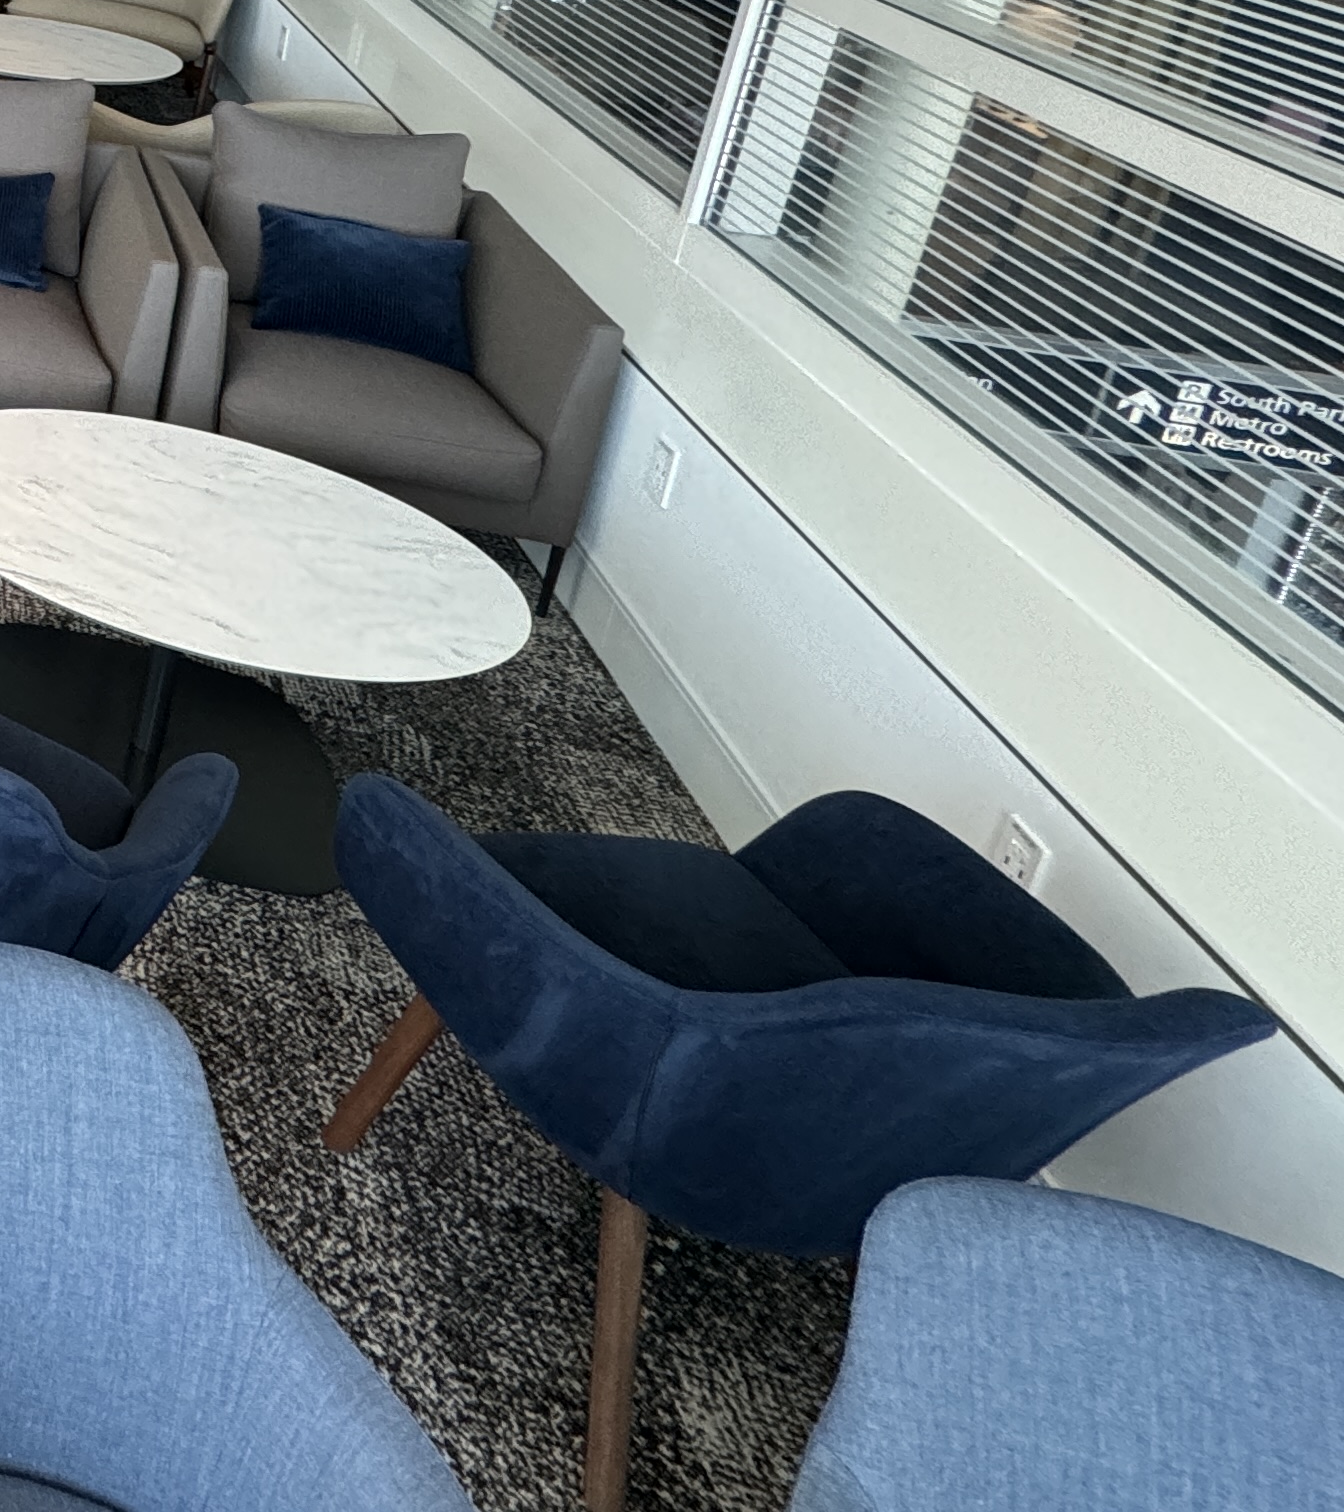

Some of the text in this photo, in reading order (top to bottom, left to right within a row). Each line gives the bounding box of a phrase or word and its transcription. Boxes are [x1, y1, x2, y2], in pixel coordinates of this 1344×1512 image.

[1217, 390, 1291, 413] South
[1297, 400, 1344, 422] Par
[1209, 411, 1288, 436] Metro
[1201, 432, 1333, 465] Restrooms
